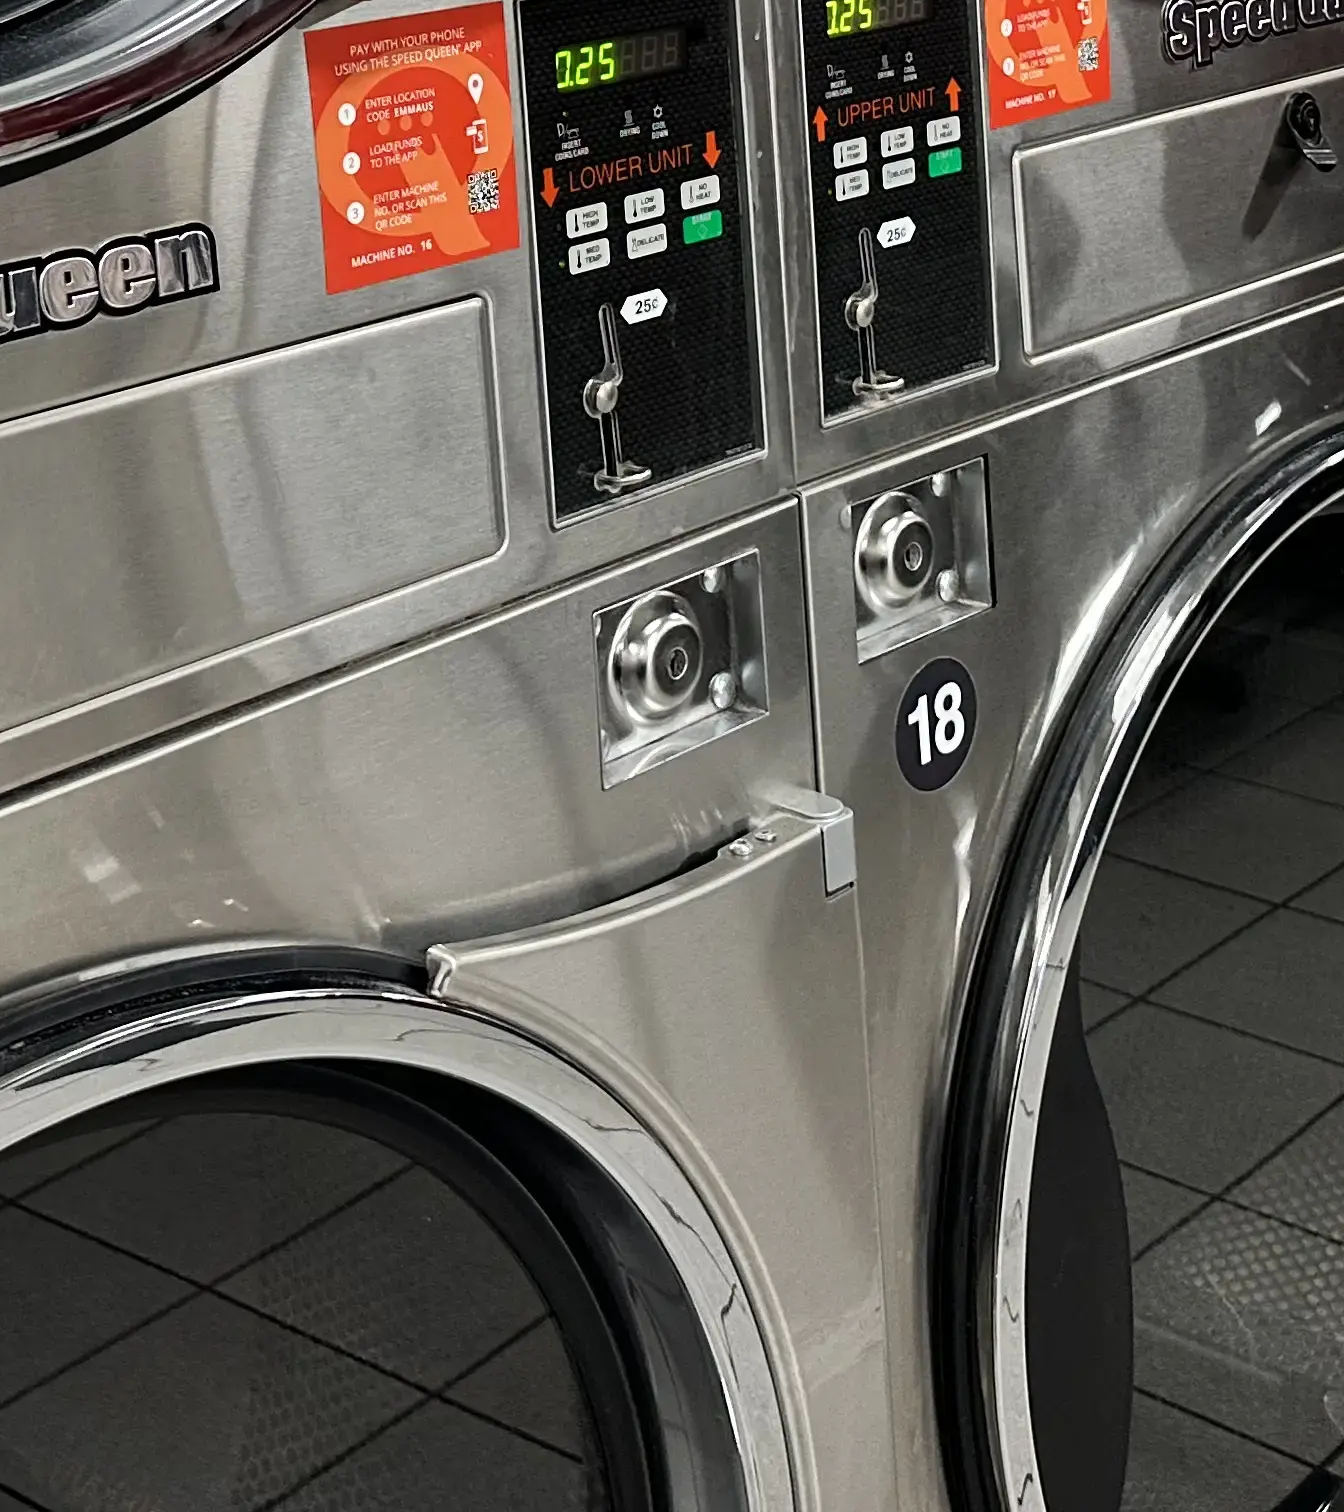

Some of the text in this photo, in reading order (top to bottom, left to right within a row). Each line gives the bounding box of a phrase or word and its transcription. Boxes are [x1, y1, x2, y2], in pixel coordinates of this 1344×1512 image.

[350, 27, 465, 57] PAY WITH YOUR PHONE
[334, 61, 367, 77] USING
[370, 57, 390, 70] THE
[392, 49, 423, 66] SPEED
[463, 40, 482, 53] APP
[365, 88, 436, 110] ENTER LOCATION
[838, 87, 936, 127] UPPER UNIT
[366, 101, 434, 123] CODE EMMAUS
[369, 142, 393, 156] LOAD
[370, 151, 418, 169] TO THE APP
[569, 143, 693, 193] LOWER UNIT
[373, 180, 439, 205] ENTER MACHINE
[392, 201, 405, 213] OR
[405, 195, 428, 211] SCAN
[429, 192, 447, 204] THIS
[640, 196, 655, 206] LOW
[375, 213, 413, 232] QR CODE
[351, 239, 433, 268] MACHINE NO. 16
[908, 681, 965, 766] 18
